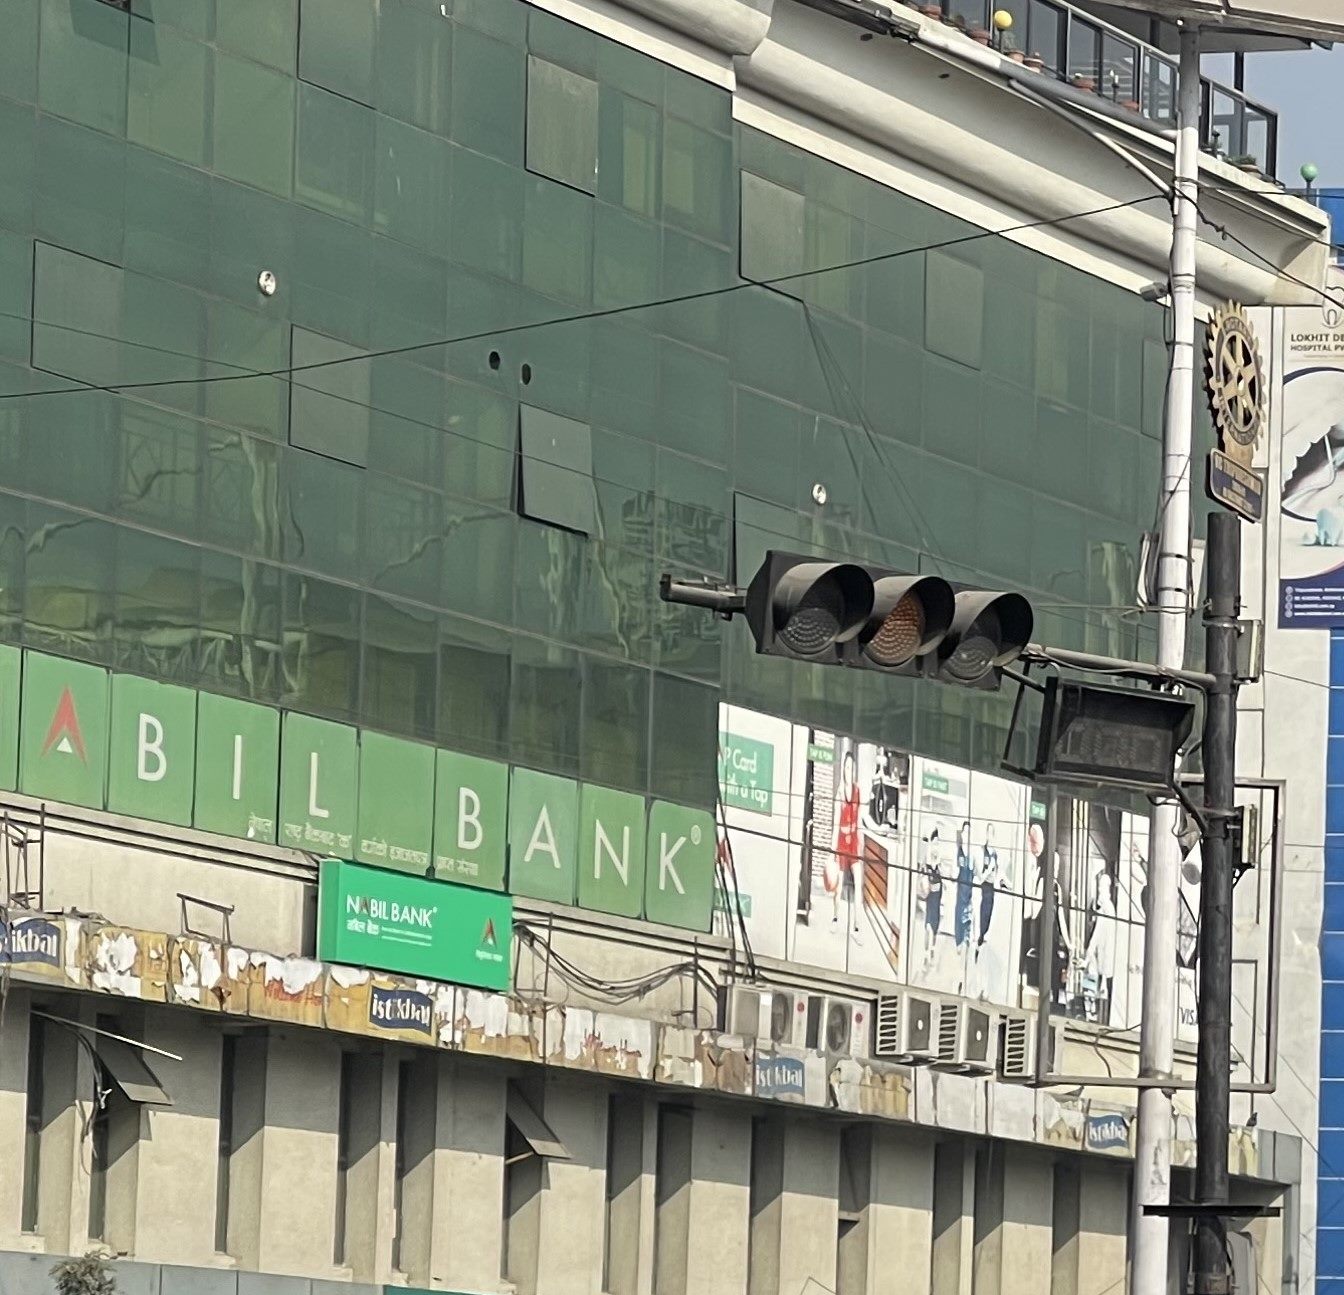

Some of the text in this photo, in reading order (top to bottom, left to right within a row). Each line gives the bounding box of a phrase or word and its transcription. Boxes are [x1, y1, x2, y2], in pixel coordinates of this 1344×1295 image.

[1290, 333, 1330, 342] LOKHIT
[346, 894, 389, 920] NABIL
[756, 1064, 803, 1088] istkbal
